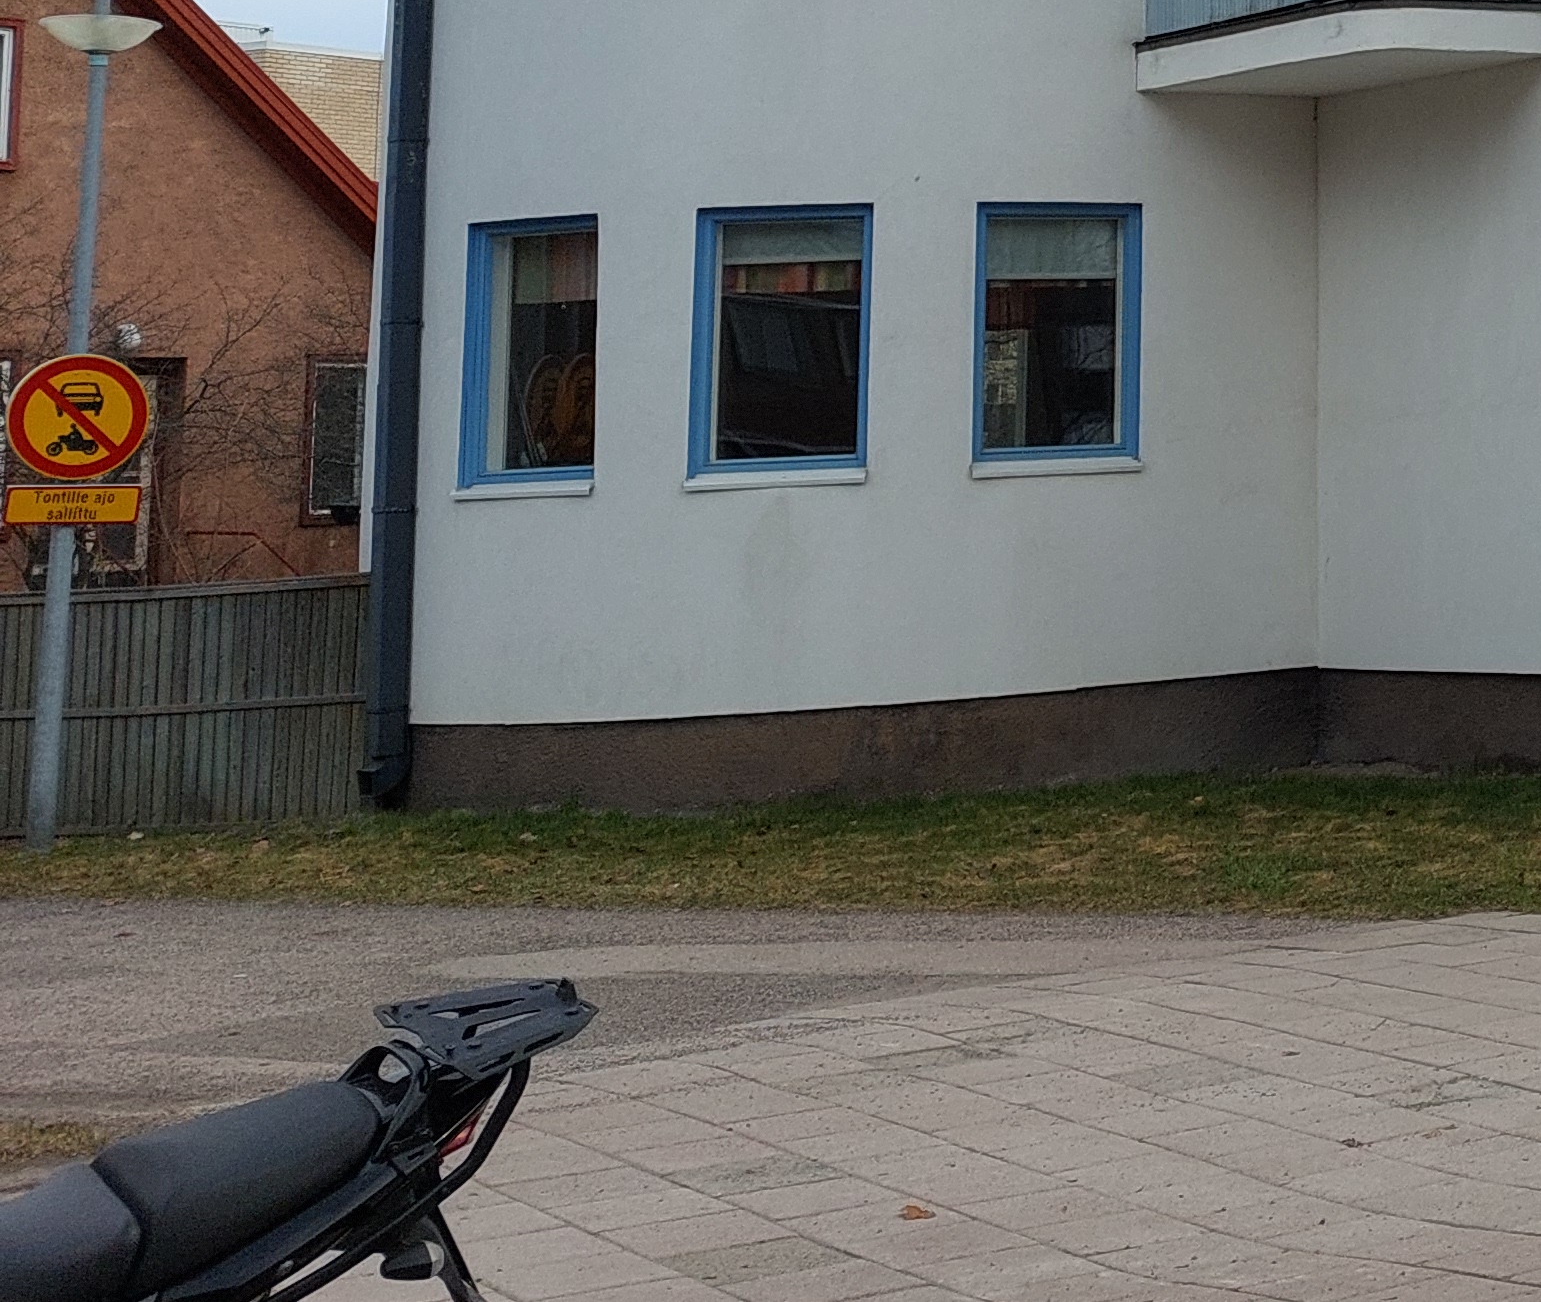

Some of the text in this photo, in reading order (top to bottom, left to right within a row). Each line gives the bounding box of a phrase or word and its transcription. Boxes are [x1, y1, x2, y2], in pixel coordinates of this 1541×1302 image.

[34, 490, 115, 505] Tontille ajo
[46, 506, 97, 521] sallittu
